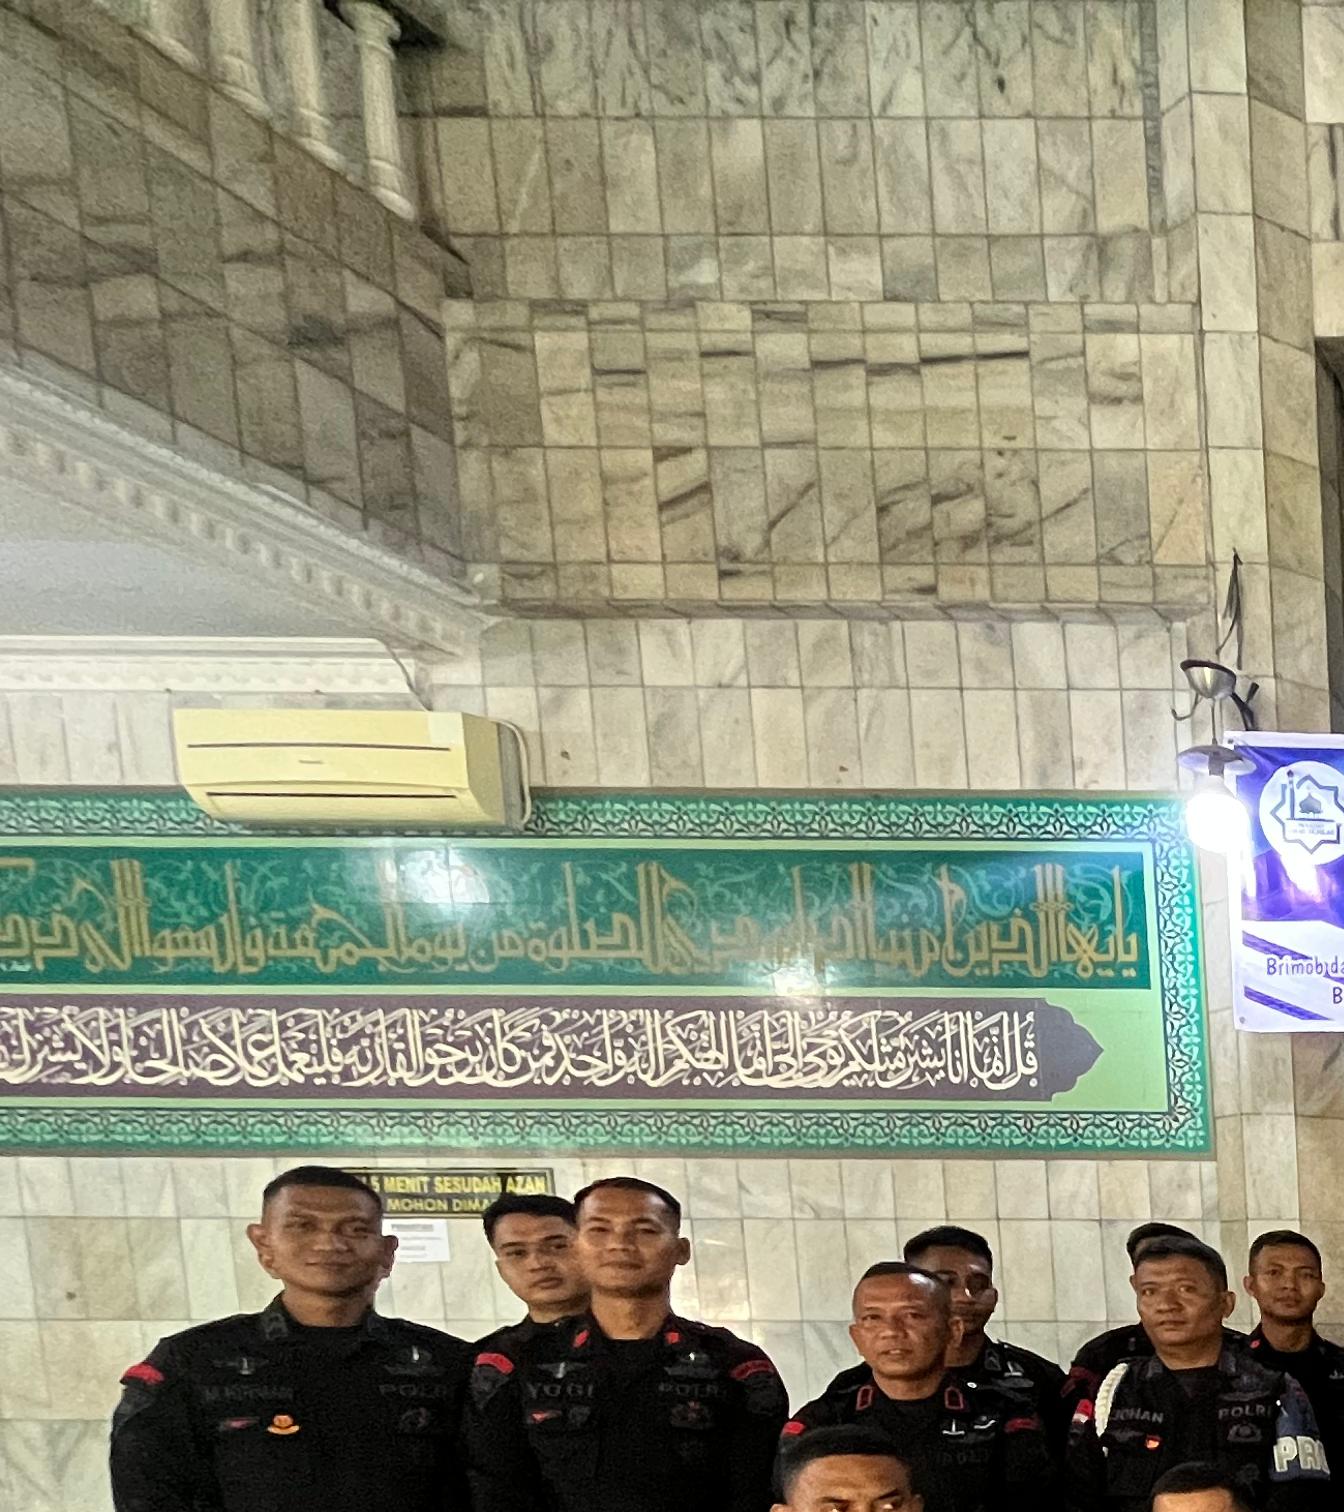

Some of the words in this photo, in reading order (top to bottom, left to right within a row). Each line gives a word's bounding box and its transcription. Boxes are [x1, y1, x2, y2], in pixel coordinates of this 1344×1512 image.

[1266, 957, 1325, 975] Brimob
[383, 1176, 430, 1193] MENIT
[434, 1176, 502, 1194] SESUDAH
[506, 1176, 546, 1194] AZAN
[525, 1381, 594, 1400] YOGI
[1217, 1403, 1273, 1420] POLRI
